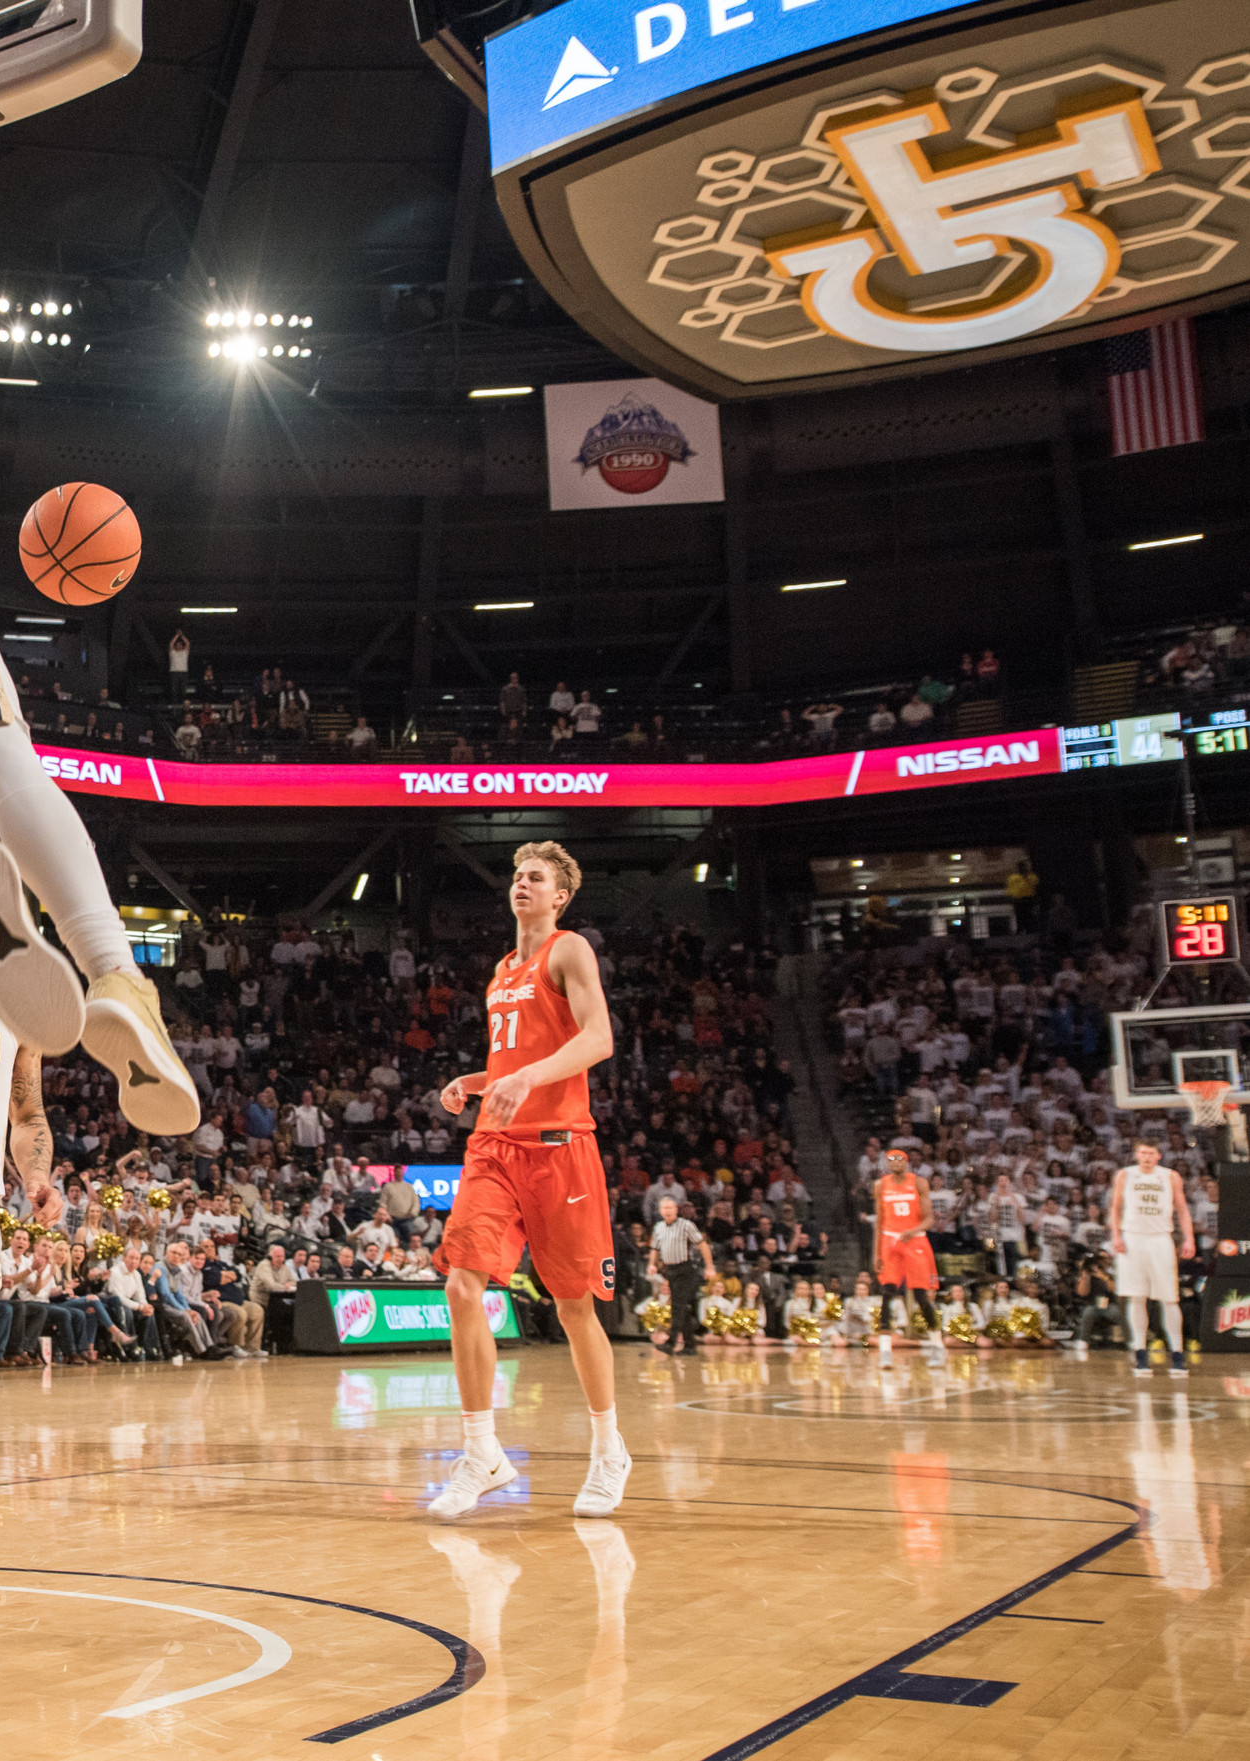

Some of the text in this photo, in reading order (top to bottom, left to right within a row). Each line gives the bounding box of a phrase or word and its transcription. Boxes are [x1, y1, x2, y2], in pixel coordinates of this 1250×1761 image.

[610, 452, 656, 468] 1990
[1130, 733, 1163, 761] 44
[1195, 727, 1248, 755] 5:11
[36, 755, 121, 785] SSAN
[897, 740, 1040, 777] NISSAN
[399, 772, 608, 793] TAKE ON TODAY
[1177, 904, 1229, 925] 5:11
[1175, 923, 1226, 957] 28
[490, 1009, 518, 1053] 21
